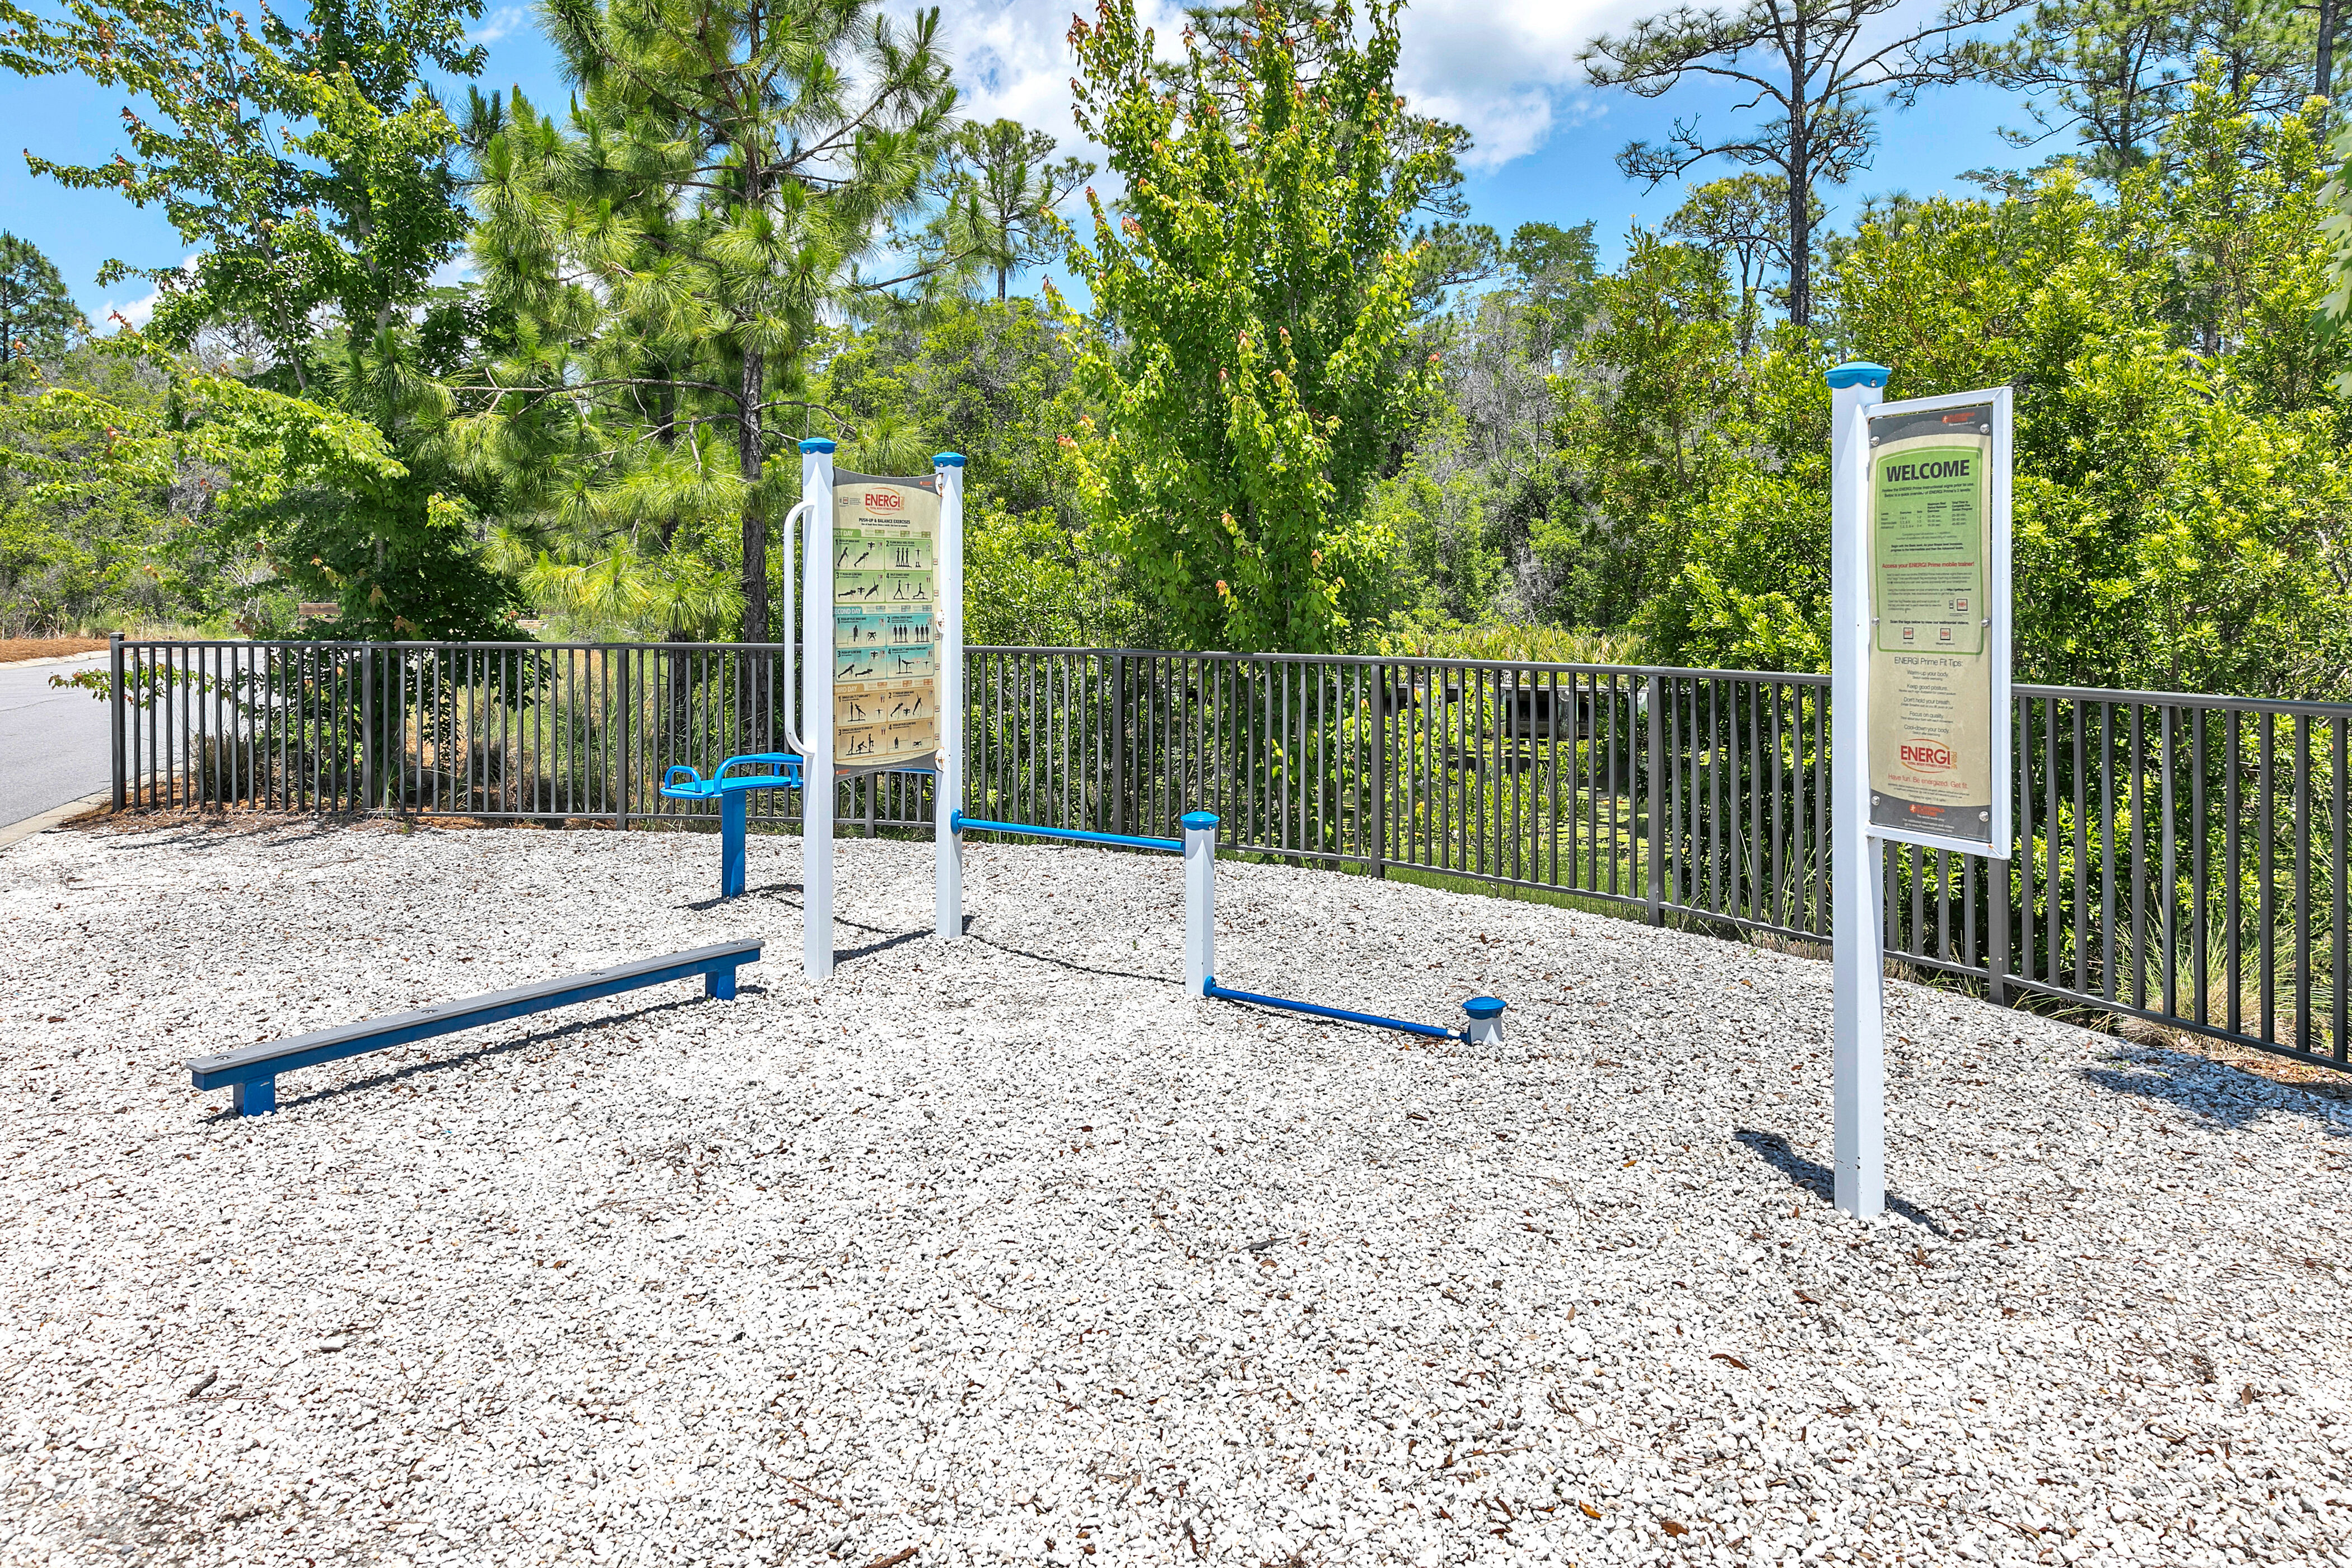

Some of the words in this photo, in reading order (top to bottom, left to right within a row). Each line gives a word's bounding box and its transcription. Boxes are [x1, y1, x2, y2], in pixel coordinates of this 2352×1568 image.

[1887, 459, 1970, 482] WELCOME
[865, 493, 900, 507] ENERGI
[1894, 656, 1919, 665] ENERGI
[1920, 657, 1938, 666] Prime
[1948, 659, 1963, 668] Tips:
[1901, 745, 1951, 765] ENERGI
